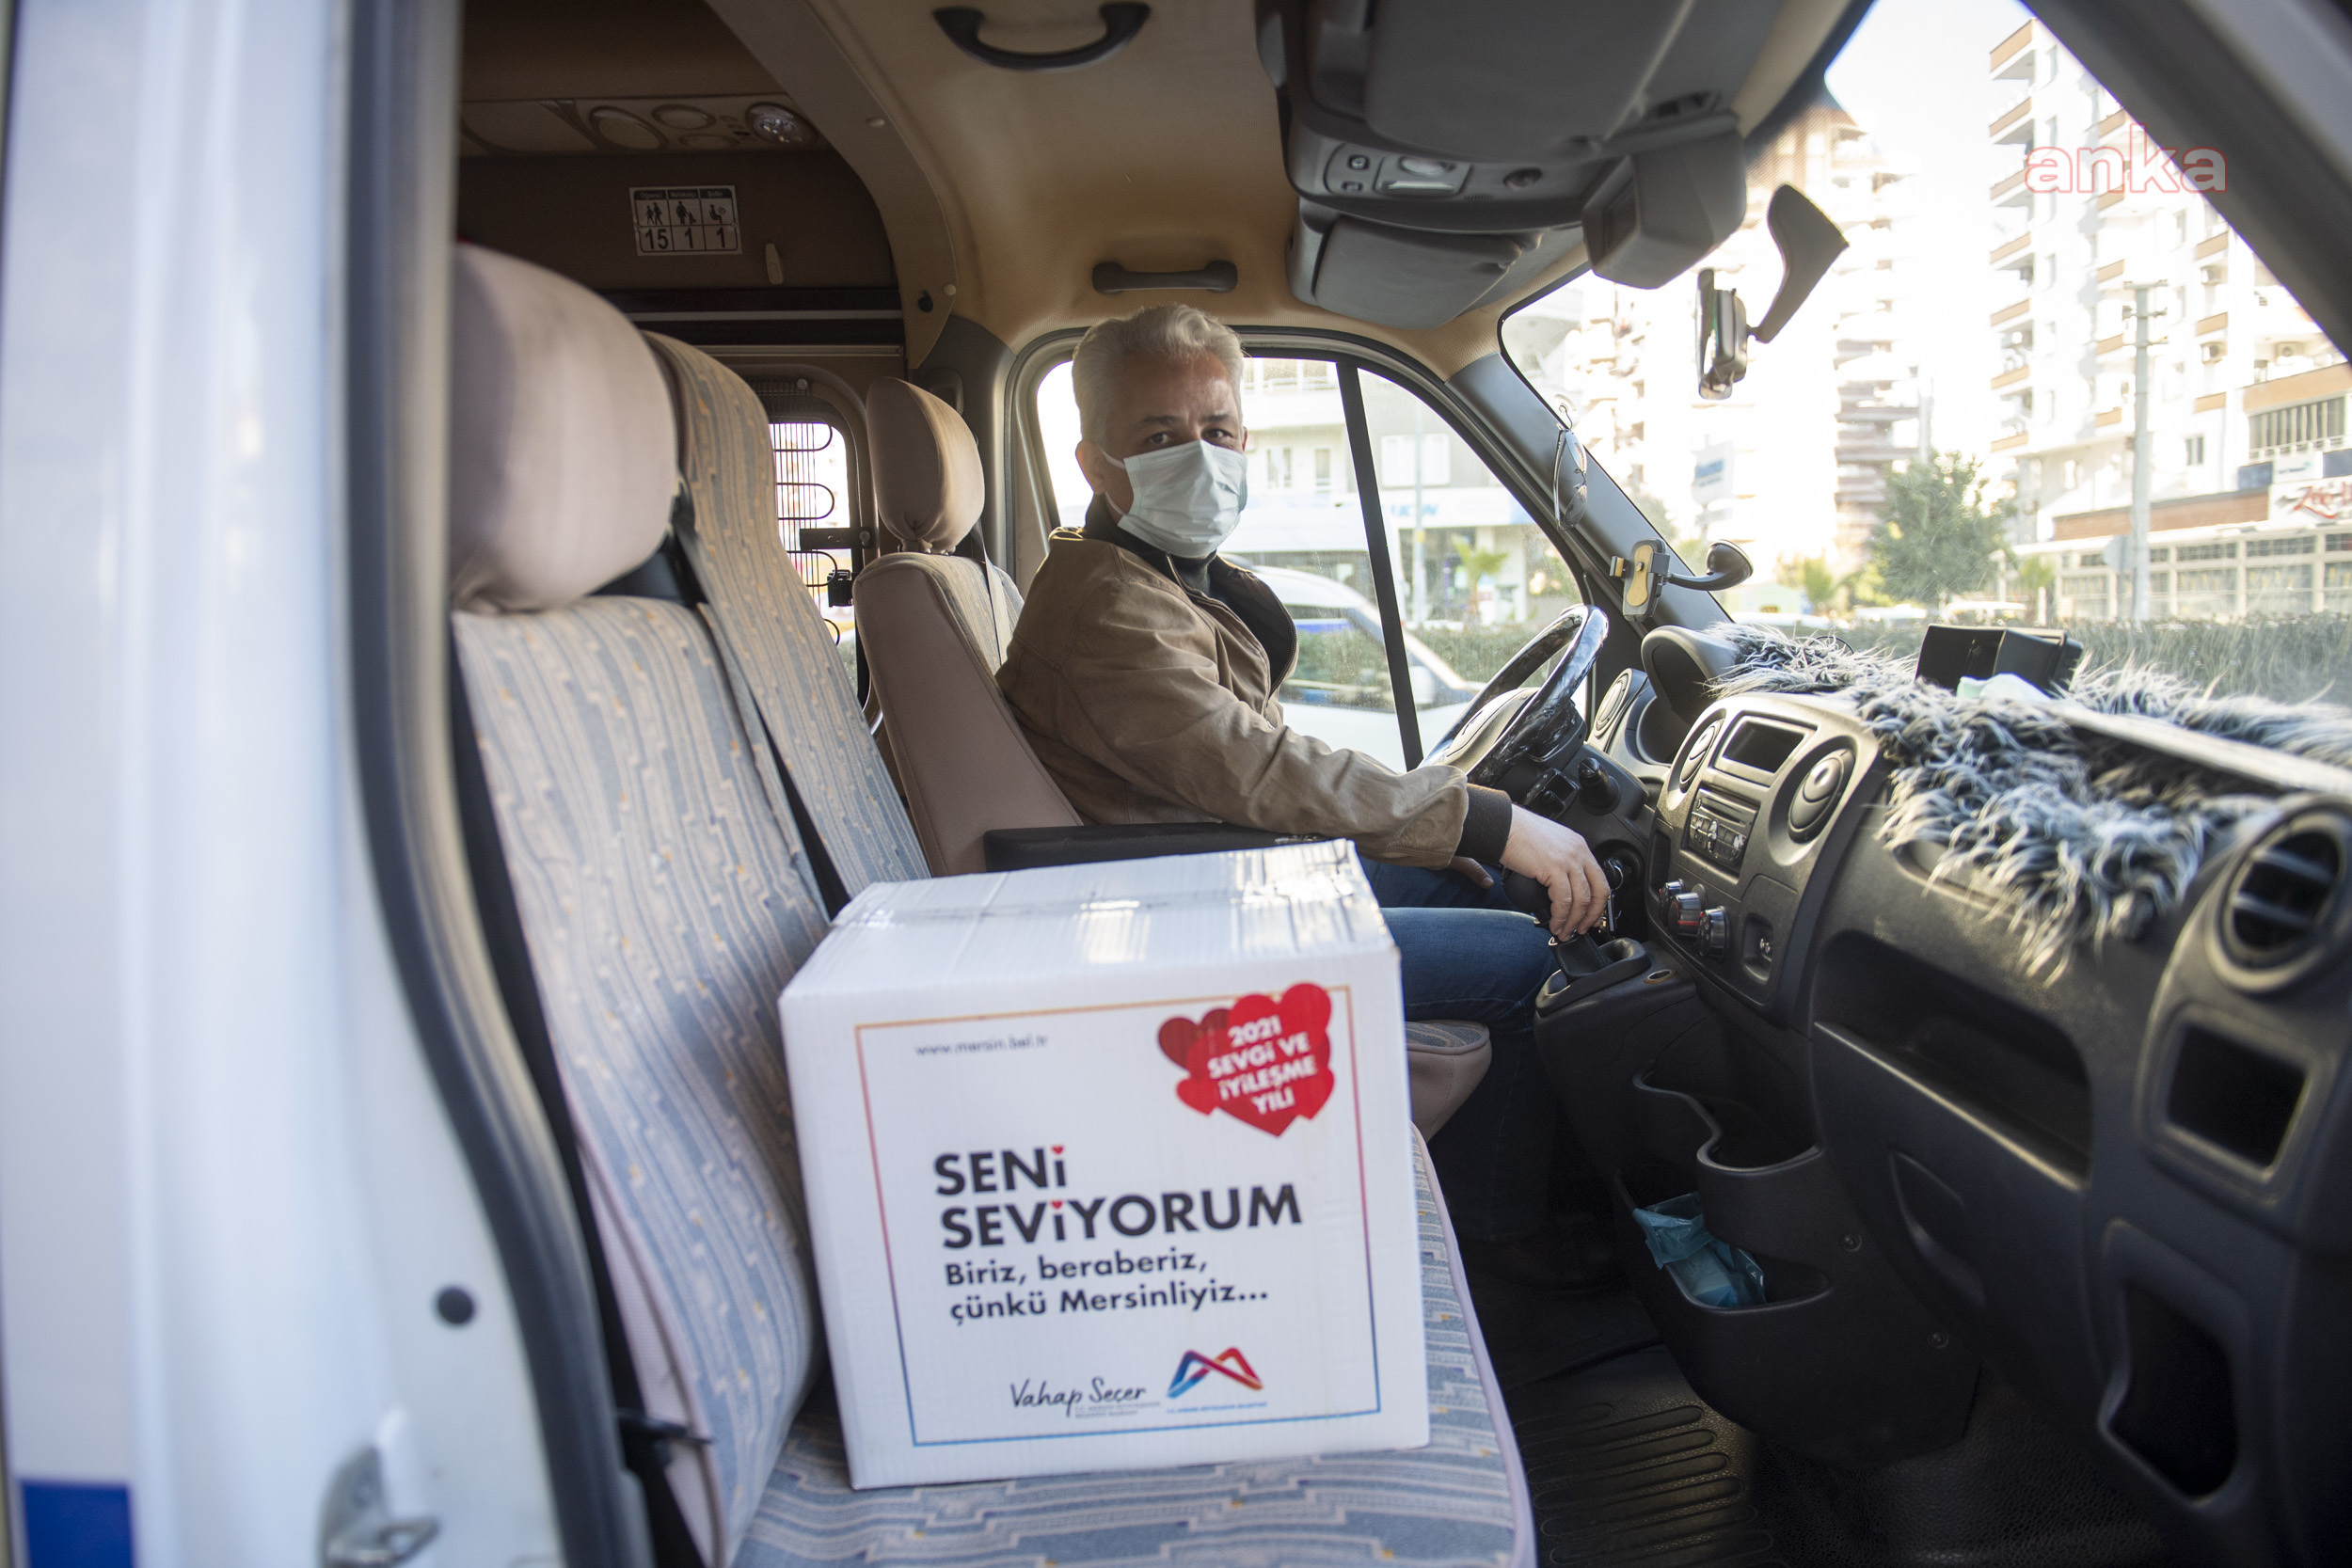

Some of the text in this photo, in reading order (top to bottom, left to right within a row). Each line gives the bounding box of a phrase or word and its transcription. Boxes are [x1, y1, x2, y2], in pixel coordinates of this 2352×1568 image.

[645, 229, 669, 249] 15
[684, 228, 693, 249] 1
[716, 227, 725, 248] 1
[1228, 1015, 1282, 1048] 2021
[1277, 1031, 1311, 1056] VE
[1250, 1086, 1295, 1115] YILI
[946, 1246, 1207, 1286] Biriz, beraberiz,
[950, 1279, 1268, 1325] çünkü Mersinliyiz...
[1010, 1378, 1082, 1418] Vahap
